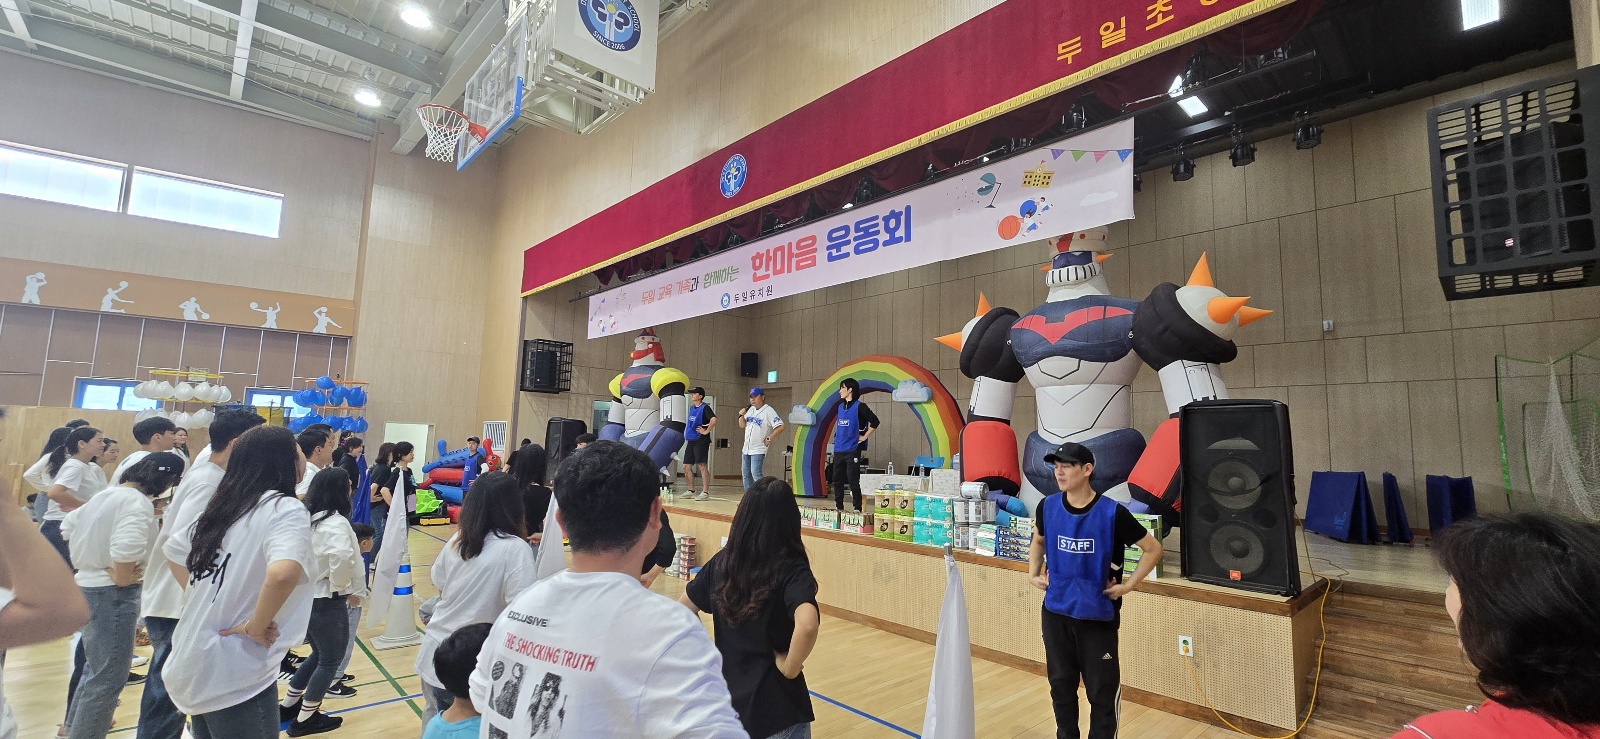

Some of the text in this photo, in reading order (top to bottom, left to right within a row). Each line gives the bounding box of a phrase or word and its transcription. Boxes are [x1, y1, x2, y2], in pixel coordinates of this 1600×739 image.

[592, 30, 611, 48] SINCE
[641, 204, 912, 305] 두일 교육 가족과 함께하는 한마음 운동회
[1060, 538, 1090, 551] STAFF
[507, 610, 549, 628] EXCLUSIVE
[504, 631, 597, 672] THE SHOCKING TRUTH
